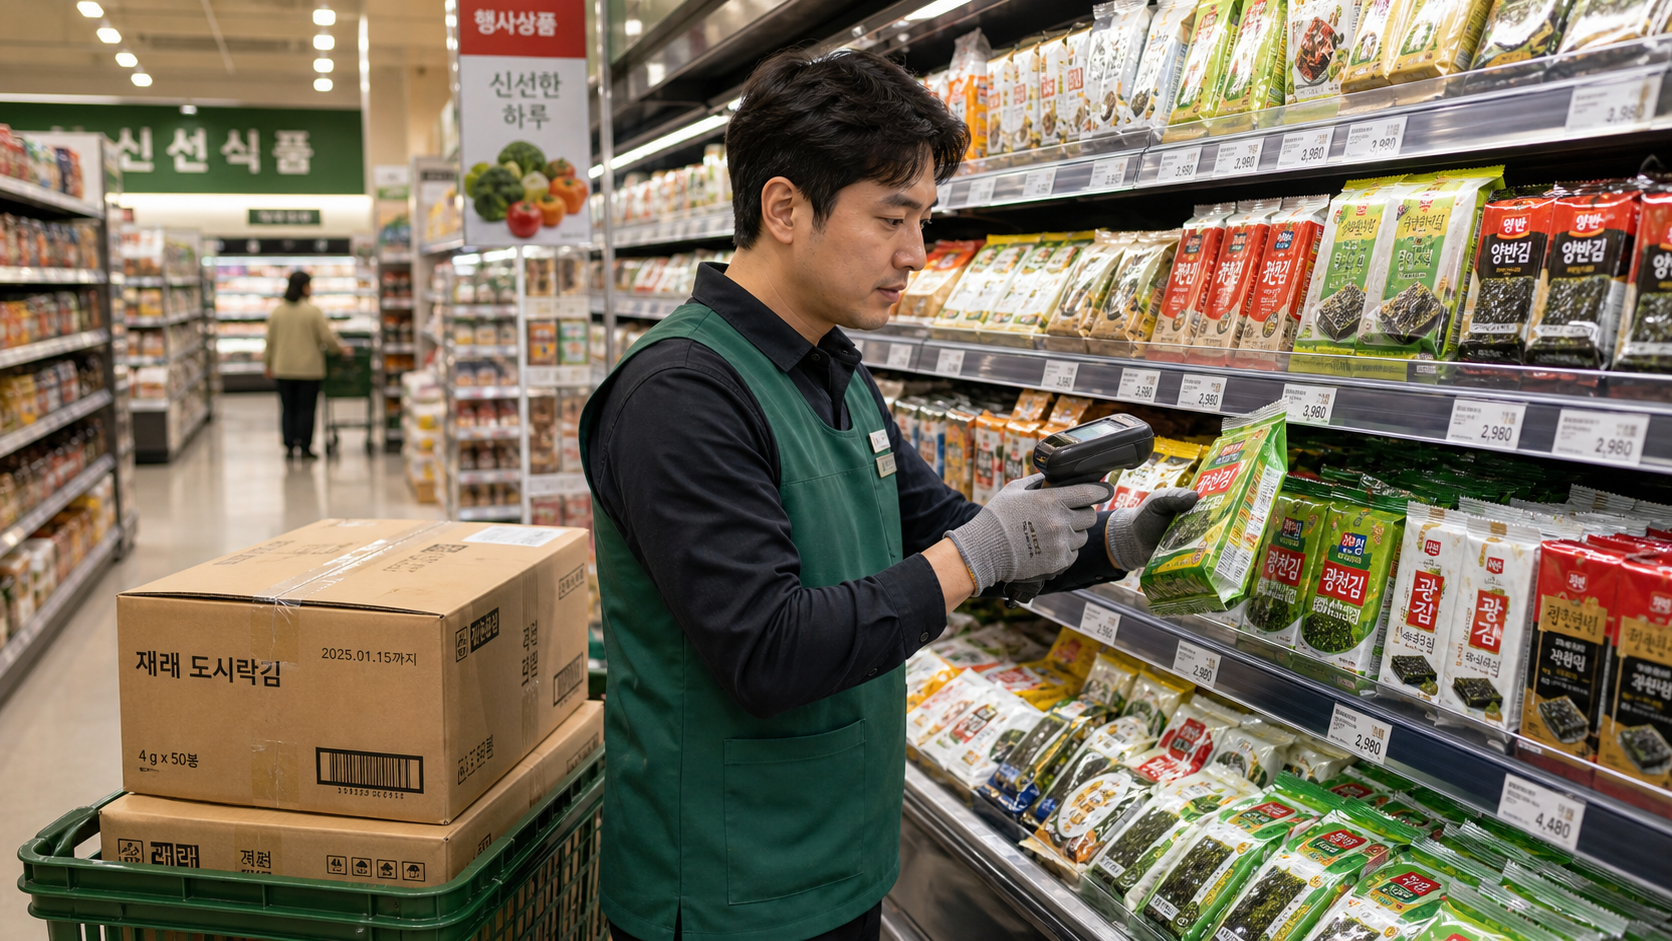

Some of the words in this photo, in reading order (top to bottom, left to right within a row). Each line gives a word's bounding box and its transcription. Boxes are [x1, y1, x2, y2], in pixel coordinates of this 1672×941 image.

[474, 9, 558, 37] 행사상품
[488, 70, 563, 100] 신선한
[502, 104, 552, 130] 하루
[117, 126, 314, 175] 신선식품
[1490, 240, 1532, 265] 양반김
[1561, 237, 1608, 265] 양반김
[1303, 404, 1327, 421] 3,980
[1480, 424, 1513, 443] 2,980
[1594, 437, 1633, 459] 2,980
[1323, 567, 1365, 600] 광천김
[135, 650, 181, 679] 재래
[189, 655, 282, 688] 도시락김
[321, 647, 418, 667] 2025.01.15까지
[1354, 733, 1382, 757] 2,980
[138, 749, 147, 762] 4
[149, 753, 158, 766] g
[160, 754, 169, 765] x
[170, 752, 199, 770] 50봉
[1533, 811, 1571, 839] 4,480
